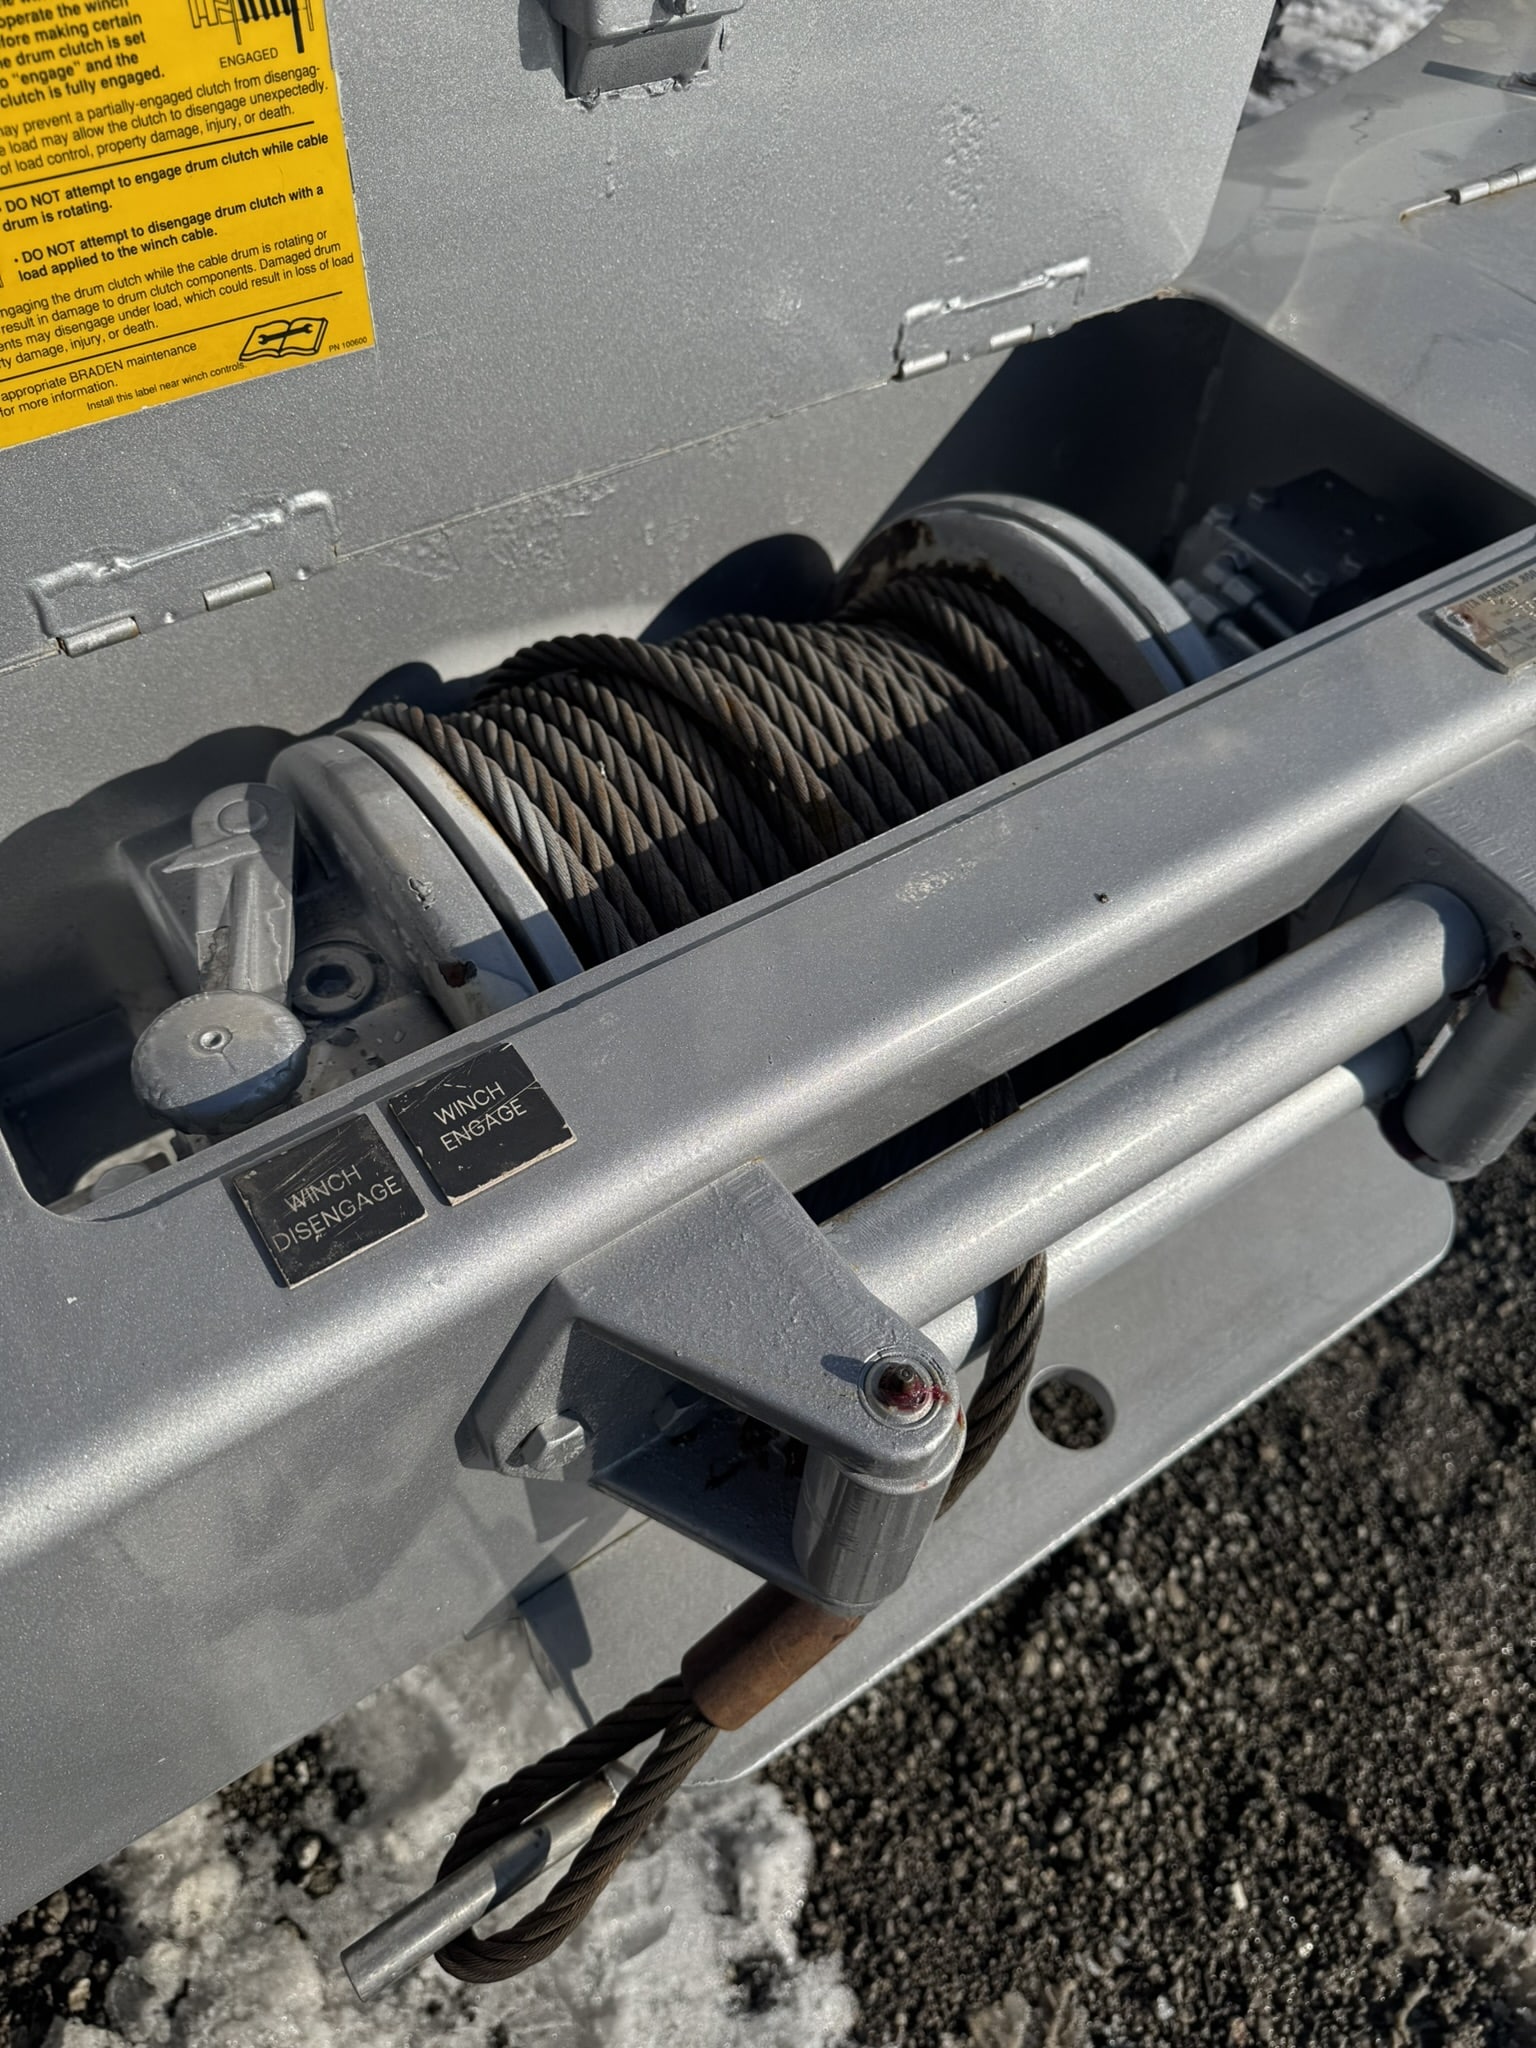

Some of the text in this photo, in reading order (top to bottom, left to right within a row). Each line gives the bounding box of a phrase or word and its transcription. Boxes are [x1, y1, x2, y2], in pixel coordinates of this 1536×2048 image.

[34, 23, 89, 42] making
[92, 12, 142, 32] certain
[56, 4, 80, 18] the
[84, 0, 128, 13] winch
[15, 49, 55, 66] drum
[58, 38, 103, 58] clutch
[106, 36, 120, 48] is
[124, 31, 145, 46] set
[86, 55, 112, 72] and
[115, 53, 138, 67] the
[219, 47, 278, 68] ENGAGED
[0, 65, 164, 108] clutch is fully engaged.
[23, 112, 72, 134] prevent
[76, 111, 84, 122] a
[87, 87, 193, 122] partially-engaged
[196, 81, 231, 97] clutch
[234, 76, 261, 89] from
[264, 65, 319, 84] disengag-
[8, 137, 38, 153] load
[41, 134, 67, 146] may
[72, 126, 104, 141] allow
[107, 121, 127, 133] the
[131, 111, 167, 128] clutch
[170, 109, 182, 120] to
[185, 97, 246, 117] disengage
[249, 79, 327, 104] unexpectedly.
[15, 155, 43, 171] load
[47, 145, 93, 165] control,
[96, 135, 146, 157] property
[150, 125, 202, 143] damage,
[206, 117, 241, 133] injury,
[244, 113, 255, 124] or
[259, 104, 294, 120] death.
[4, 133, 328, 213] DO NOT attempt to engage drum clutch while cable
[2, 200, 112, 232] drum is rotating.
[21, 186, 323, 263] DO NOT attempt to disengage drum clutch with a
[18, 226, 217, 281] load applied to the winch cable.
[51, 293, 70, 305] the
[74, 284, 104, 299] drum
[107, 274, 142, 291] clutch
[144, 266, 174, 281] while
[176, 262, 195, 274] the
[198, 253, 228, 268] cable
[230, 247, 259, 261] drum
[262, 243, 271, 253] is
[274, 234, 314, 250] rotating
[316, 230, 326, 240] or
[1, 243, 340, 334] result in damage to drum clutch components. Damaged drum
[25, 331, 50, 344] may
[54, 315, 114, 337] disengage
[117, 305, 150, 321] under
[153, 296, 181, 311] load,
[183, 287, 216, 304] which
[219, 278, 248, 295] could
[251, 271, 280, 287] result
[283, 269, 292, 279] in
[295, 264, 316, 276] loss
[319, 258, 329, 270] of
[331, 252, 354, 267] load
[15, 344, 67, 363] damage,
[69, 334, 105, 349] injury,
[108, 329, 119, 339] or
[122, 319, 158, 335] death.
[329, 336, 367, 353] PN 100600
[1, 342, 196, 402] appropriate BRADEN maintenance
[18, 397, 48, 412] more
[50, 379, 117, 403] information.
[87, 363, 247, 410] Install this label near winch controls.
[433, 1081, 506, 1126] WINCH
[439, 1098, 527, 1152] ENGAGE
[284, 1164, 362, 1213] WINCH
[271, 1175, 402, 1253] DISENGAGE
